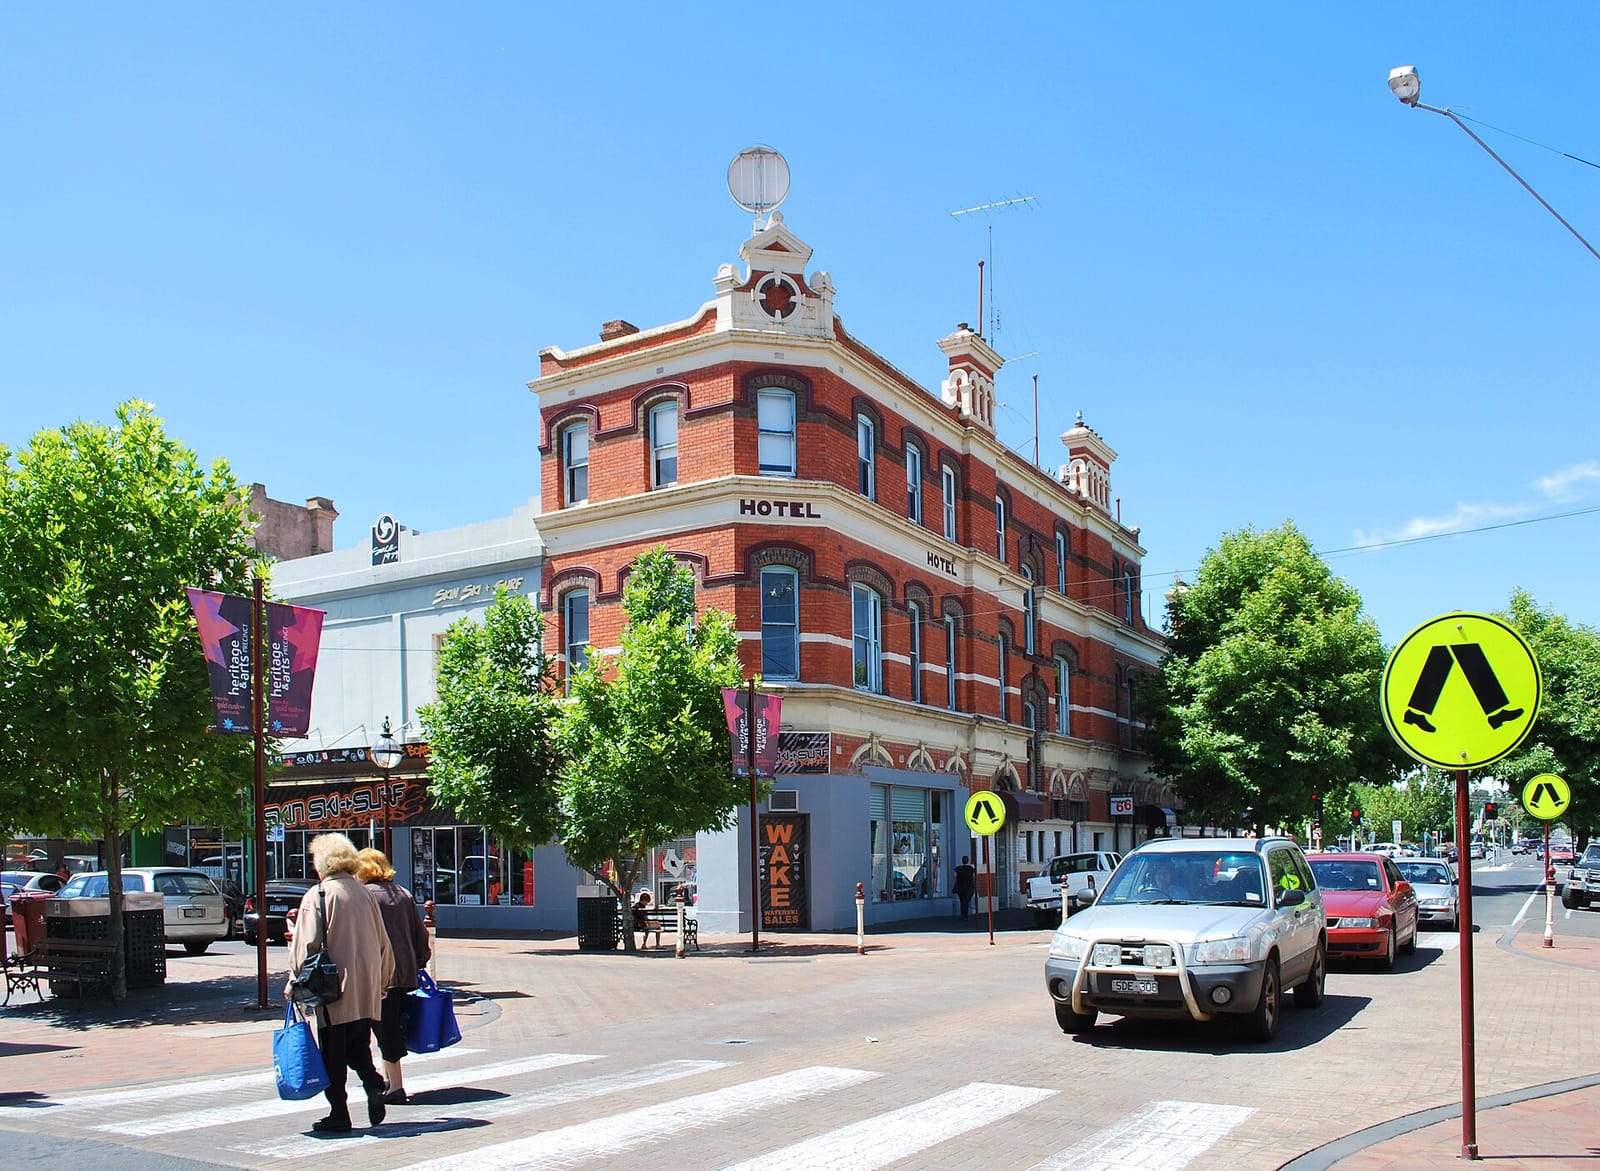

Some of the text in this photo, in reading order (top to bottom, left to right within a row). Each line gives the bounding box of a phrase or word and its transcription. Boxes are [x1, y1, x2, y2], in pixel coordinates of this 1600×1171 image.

[739, 499, 821, 519] HOTEL
[927, 551, 957, 577] HOTEL
[432, 587, 459, 605] SKIN
[460, 584, 481, 601] SKI
[228, 640, 242, 696] heritage
[270, 642, 284, 697] heritage
[755, 718, 763, 754] heritage
[1116, 799, 1132, 812] 66
[766, 824, 794, 907] WAKE
[764, 916, 799, 925] SALES
[1115, 981, 1134, 991] SDE
